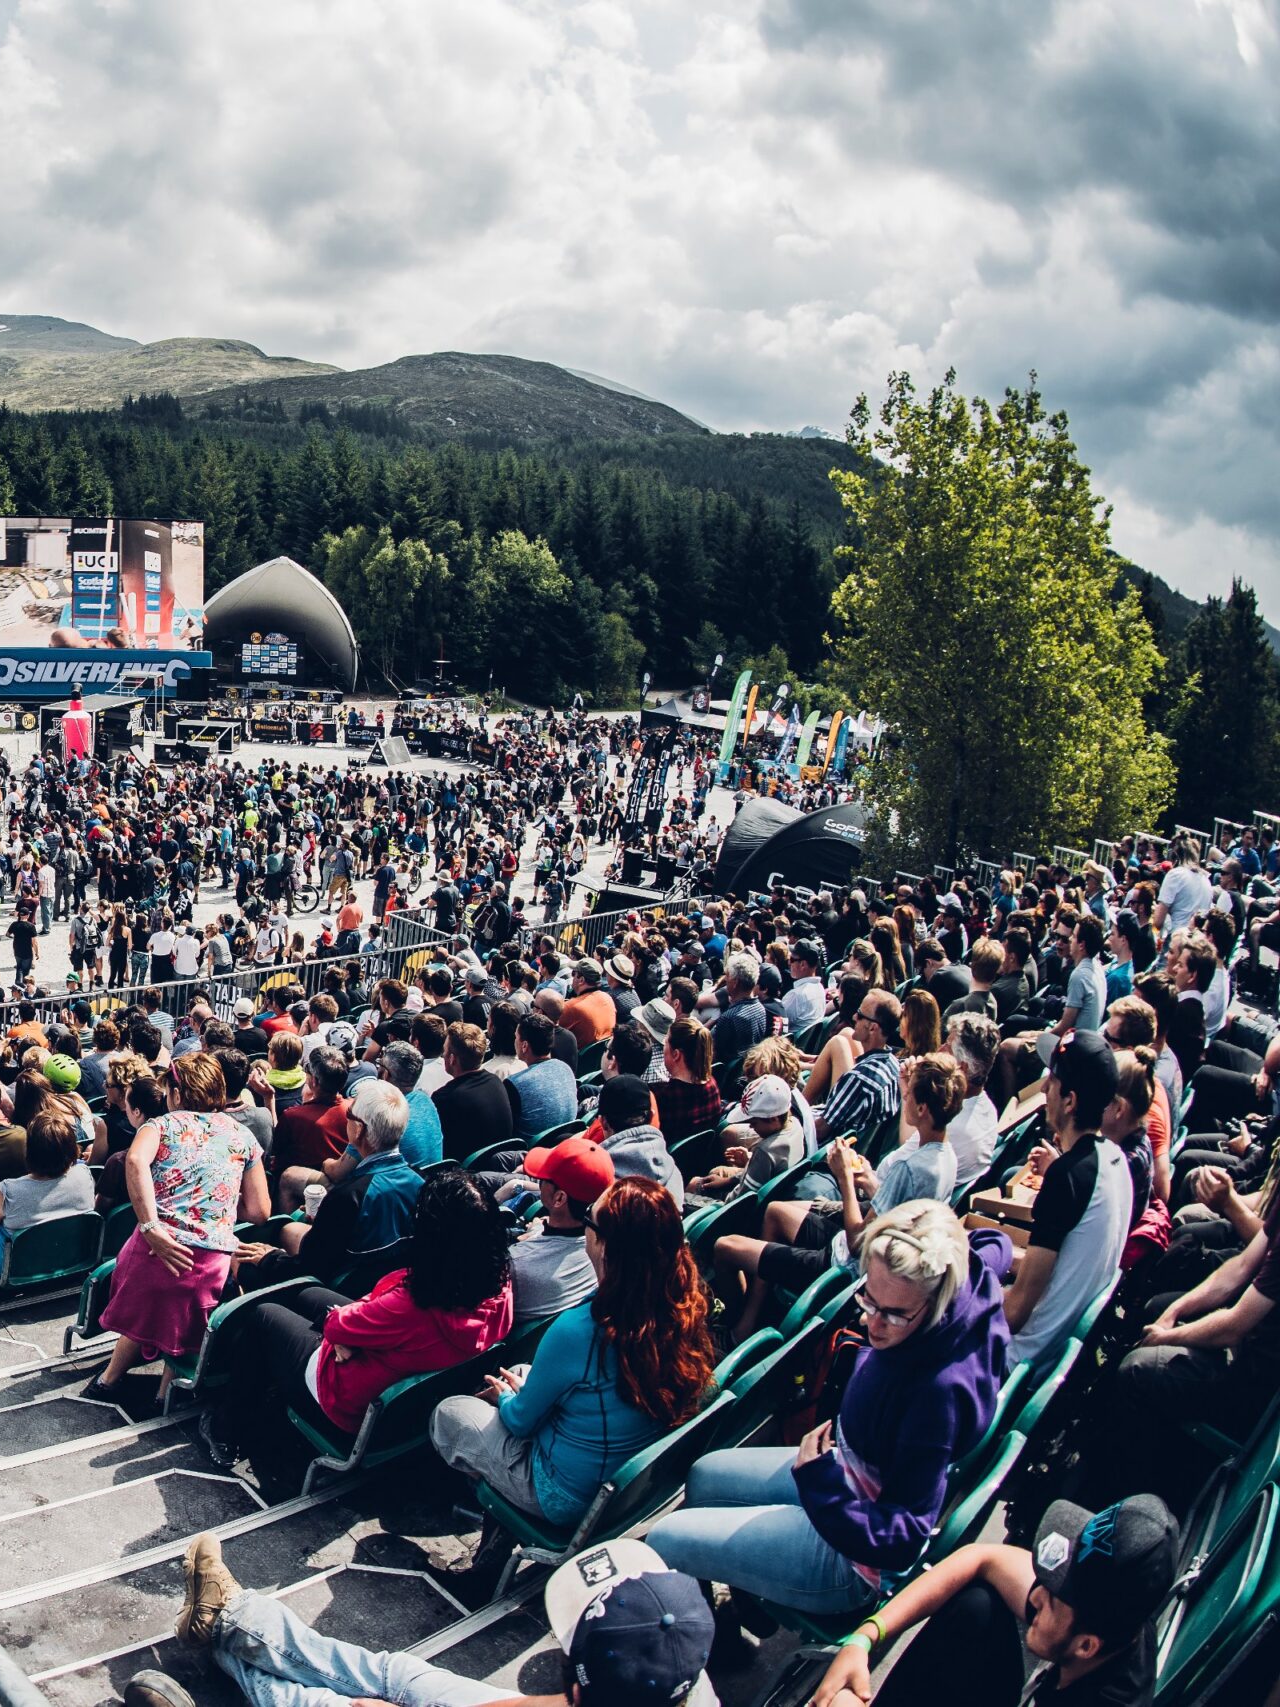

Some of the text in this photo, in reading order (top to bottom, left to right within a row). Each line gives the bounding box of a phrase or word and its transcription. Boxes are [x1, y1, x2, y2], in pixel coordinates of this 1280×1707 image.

[85, 555, 114, 568] UCI
[255, 723, 284, 731] Continental
[347, 728, 381, 737] GoPro
[648, 750, 670, 811] GoPro
[824, 818, 871, 837] GoPro
